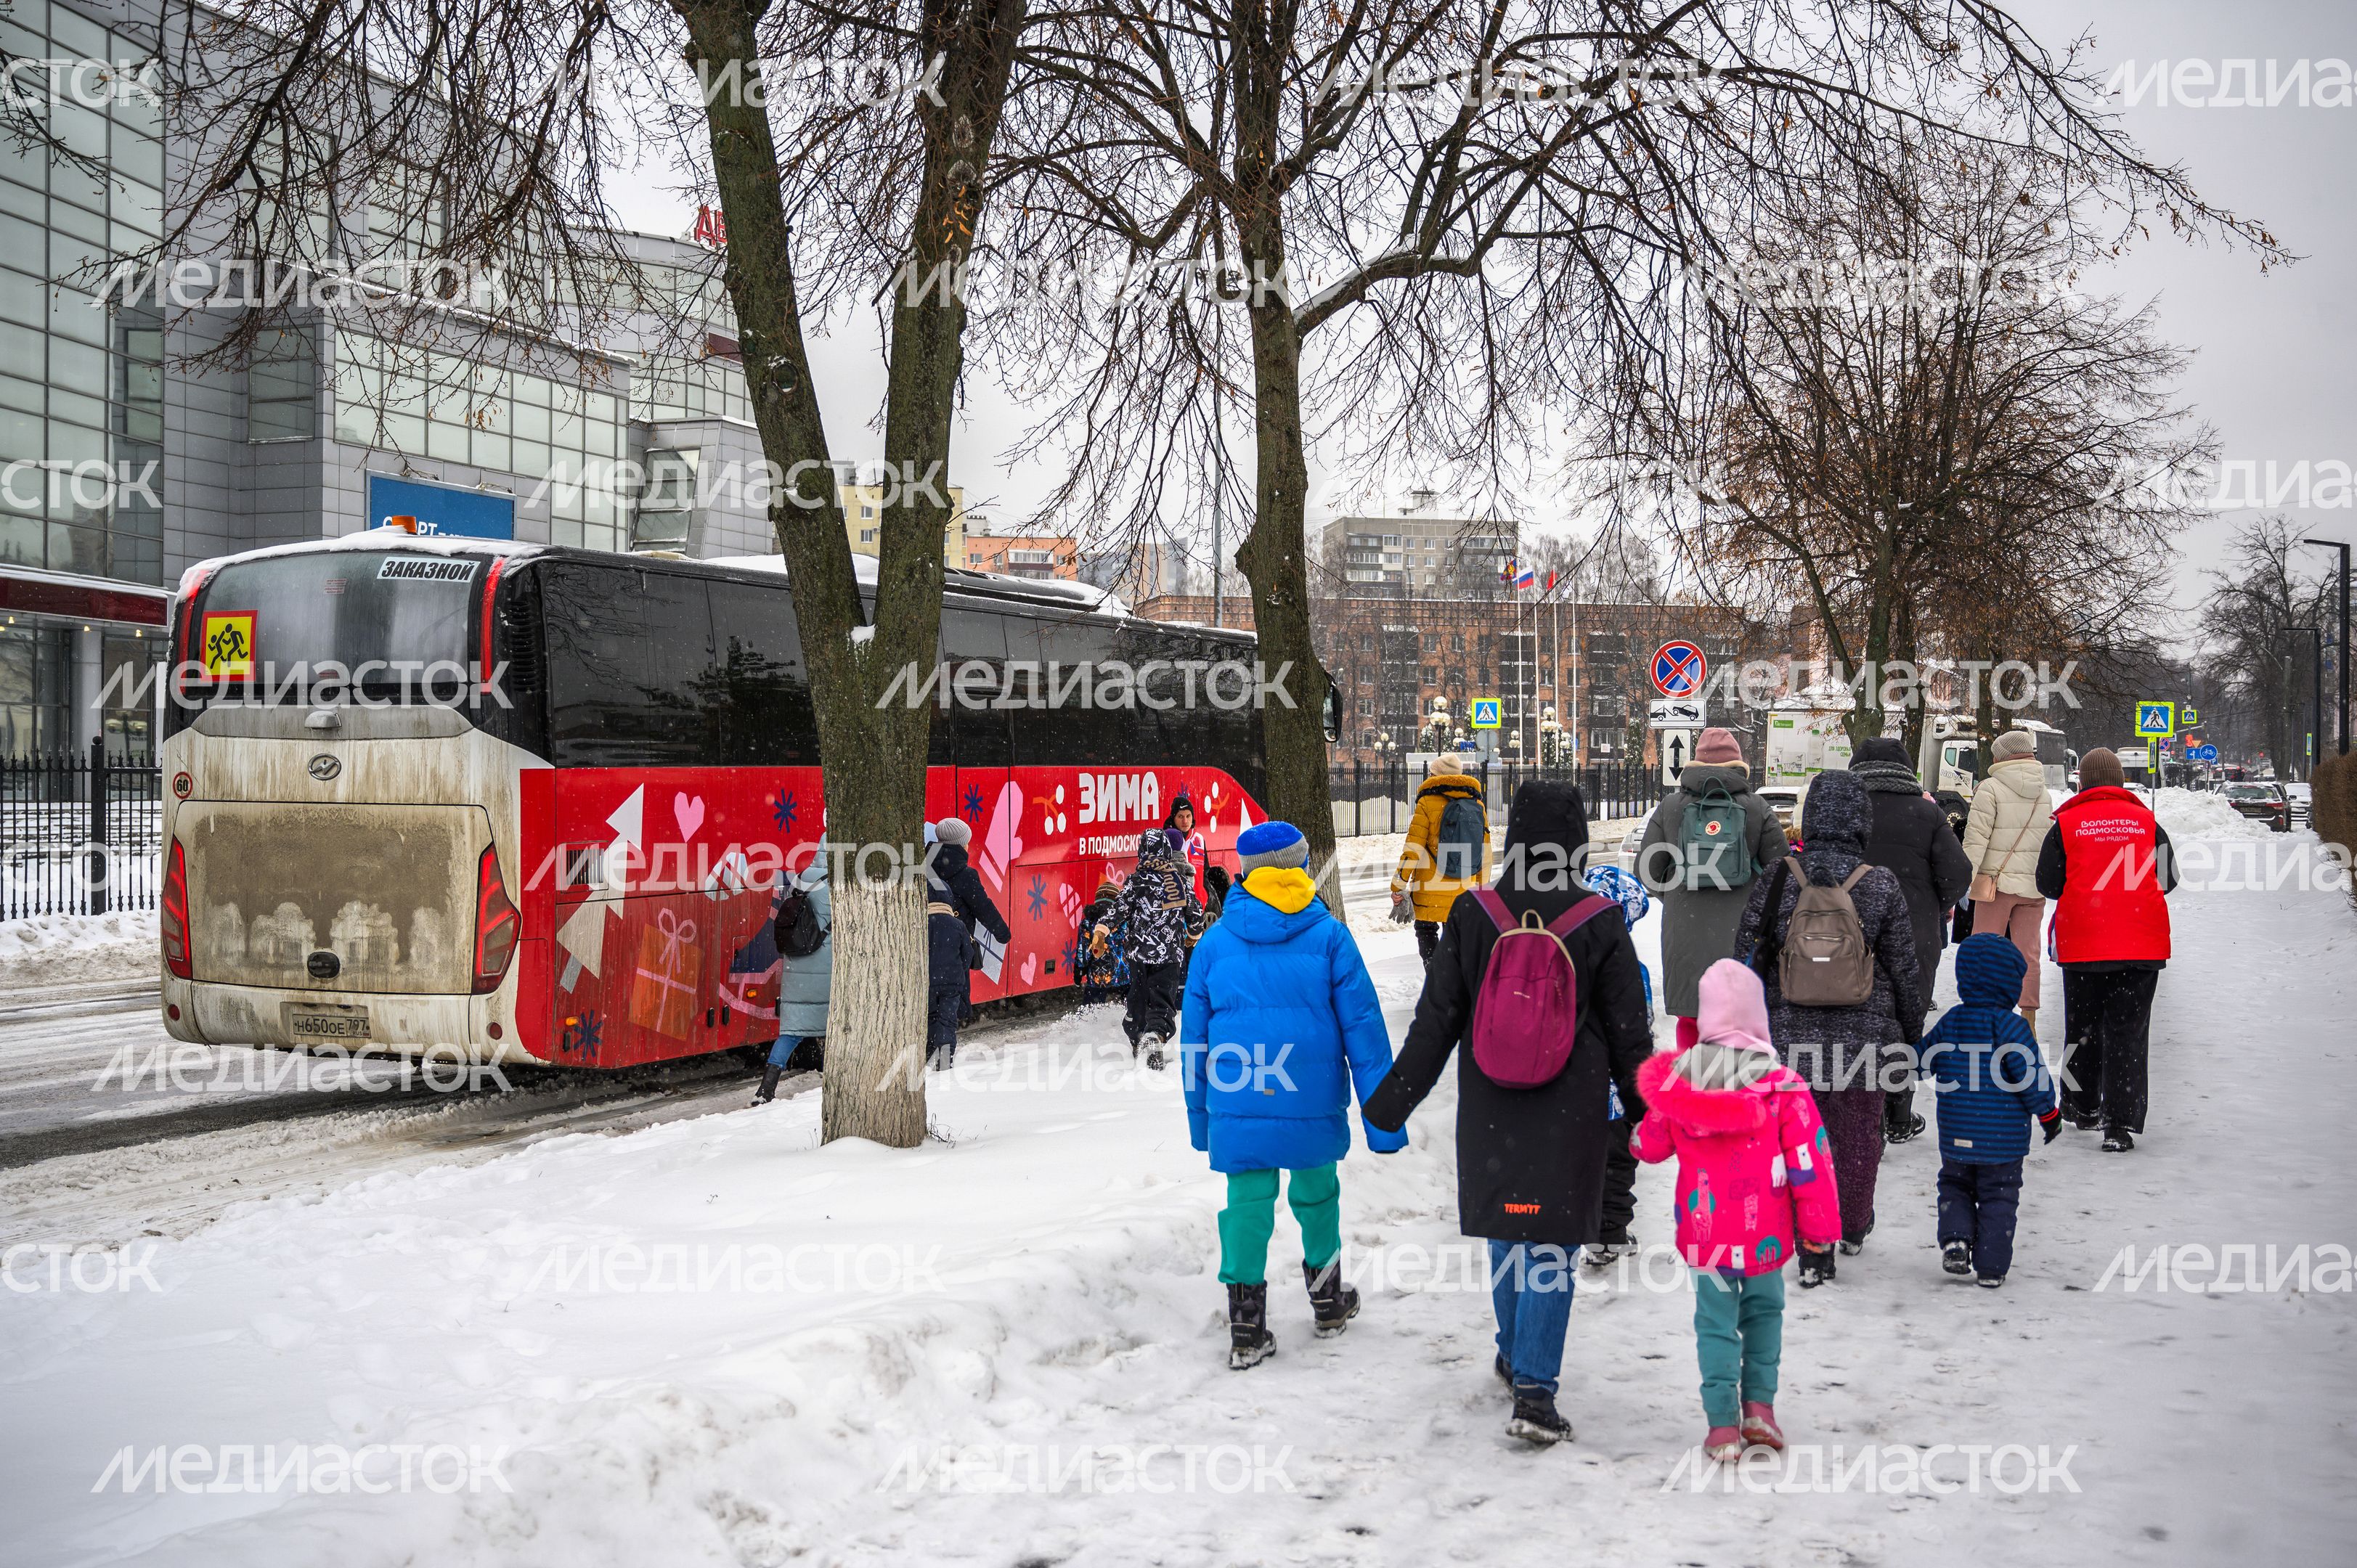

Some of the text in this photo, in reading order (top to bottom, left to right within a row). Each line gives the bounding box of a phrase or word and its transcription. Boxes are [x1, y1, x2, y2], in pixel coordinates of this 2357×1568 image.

[382, 561, 475, 581] ЗАКАЗНОЙ
[1940, 769, 1971, 785] NOVUS
[176, 779, 189, 792] 60
[1079, 771, 1160, 824] ЗИМА
[2081, 819, 2139, 828] ВОЛОНТЕРЫ
[2075, 826, 2146, 837] ПОДМОСКОВЬЯ
[1079, 833, 1141, 857] В ПОДМОСКО
[346, 1019, 367, 1031] 797
